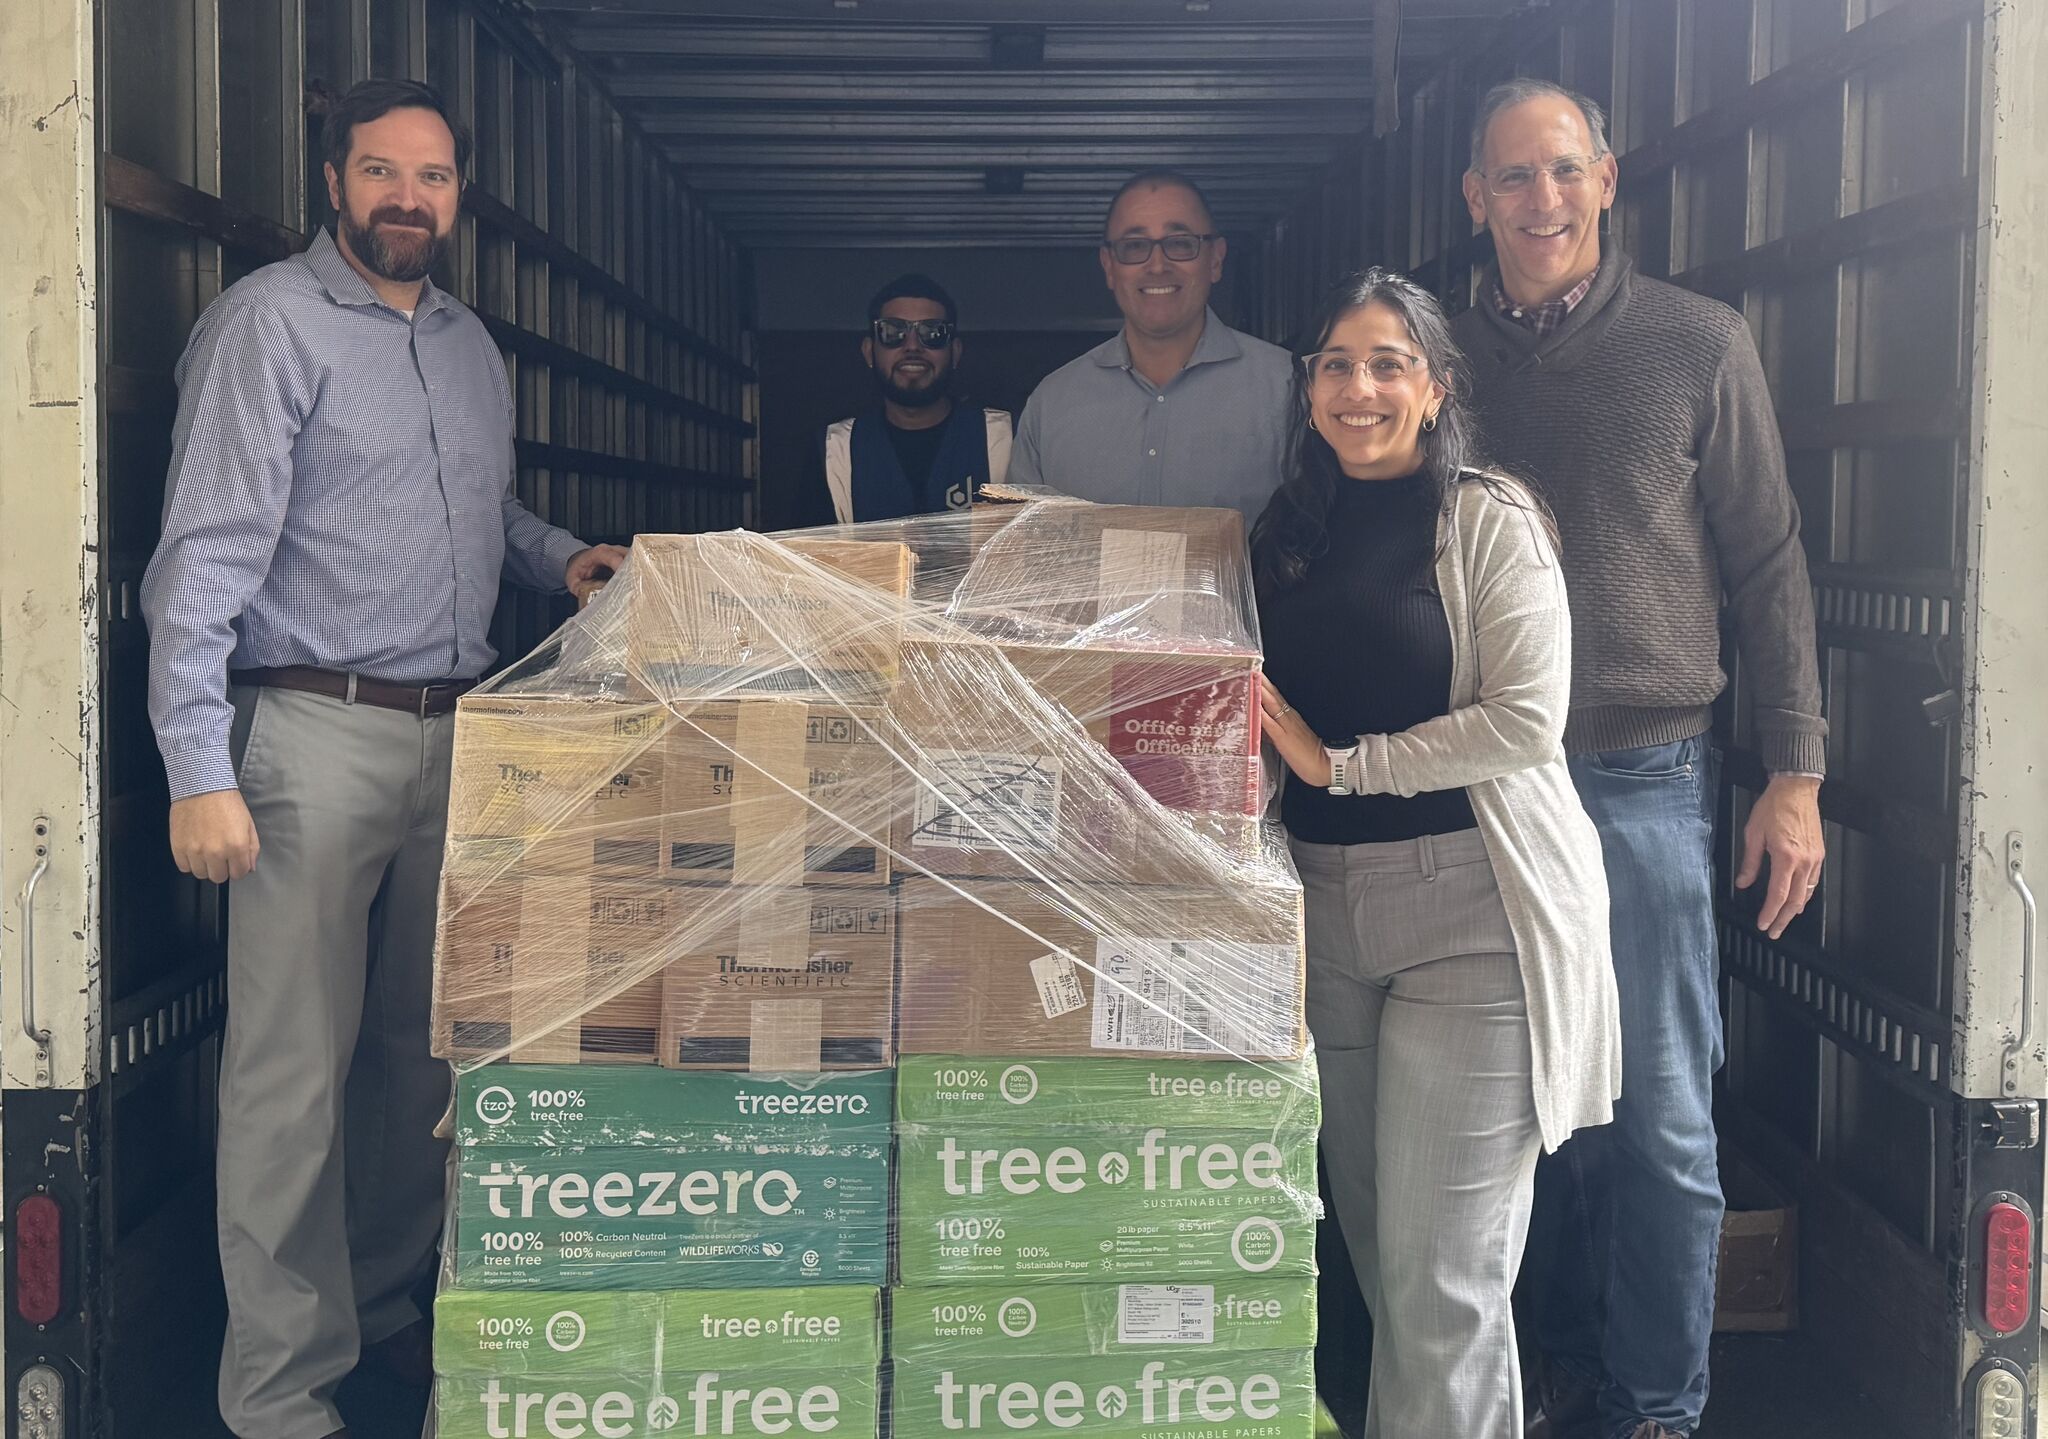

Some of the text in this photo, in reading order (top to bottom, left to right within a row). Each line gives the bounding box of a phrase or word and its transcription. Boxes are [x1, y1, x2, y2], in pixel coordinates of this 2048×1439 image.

[1125, 719, 1186, 736] Office
[719, 976, 851, 988] SCIENTIFIC
[933, 1070, 989, 1087] 100%
[1147, 1072, 1281, 1098] tree free
[528, 1090, 586, 1108] 100%
[936, 1089, 985, 1100] tree free
[735, 1090, 869, 1114] treezero
[531, 1110, 584, 1121] tree free
[937, 1128, 1284, 1195] tree free
[479, 1163, 802, 1218] treezero
[1144, 1195, 1284, 1208] SUSTAINABLE PAPERS
[935, 1218, 1005, 1240] 100%
[1137, 1226, 1159, 1235] paper
[480, 1232, 544, 1251] 100%
[559, 1231, 667, 1243] 100% Carbon Neutral
[1245, 1232, 1271, 1241] 100%
[679, 1244, 760, 1257] WILDLIFEWORKS
[940, 1243, 1002, 1257] tree free
[1245, 1241, 1271, 1249] Carbon
[559, 1247, 666, 1260] 100% Recycled Content
[1016, 1247, 1050, 1258] 100%
[484, 1253, 542, 1266] tree free
[1016, 1260, 1089, 1270] Sustainable Paper
[1224, 1294, 1282, 1319] free
[931, 1305, 987, 1323] 100%
[476, 1317, 534, 1336] 100%
[701, 1310, 841, 1338] tree free
[935, 1325, 984, 1336] tree free
[479, 1339, 530, 1350] tree free
[934, 1361, 1281, 1430] tree free
[480, 1373, 840, 1439] tree free
[1141, 1426, 1282, 1439] SUSTAINABLE PAPERS
